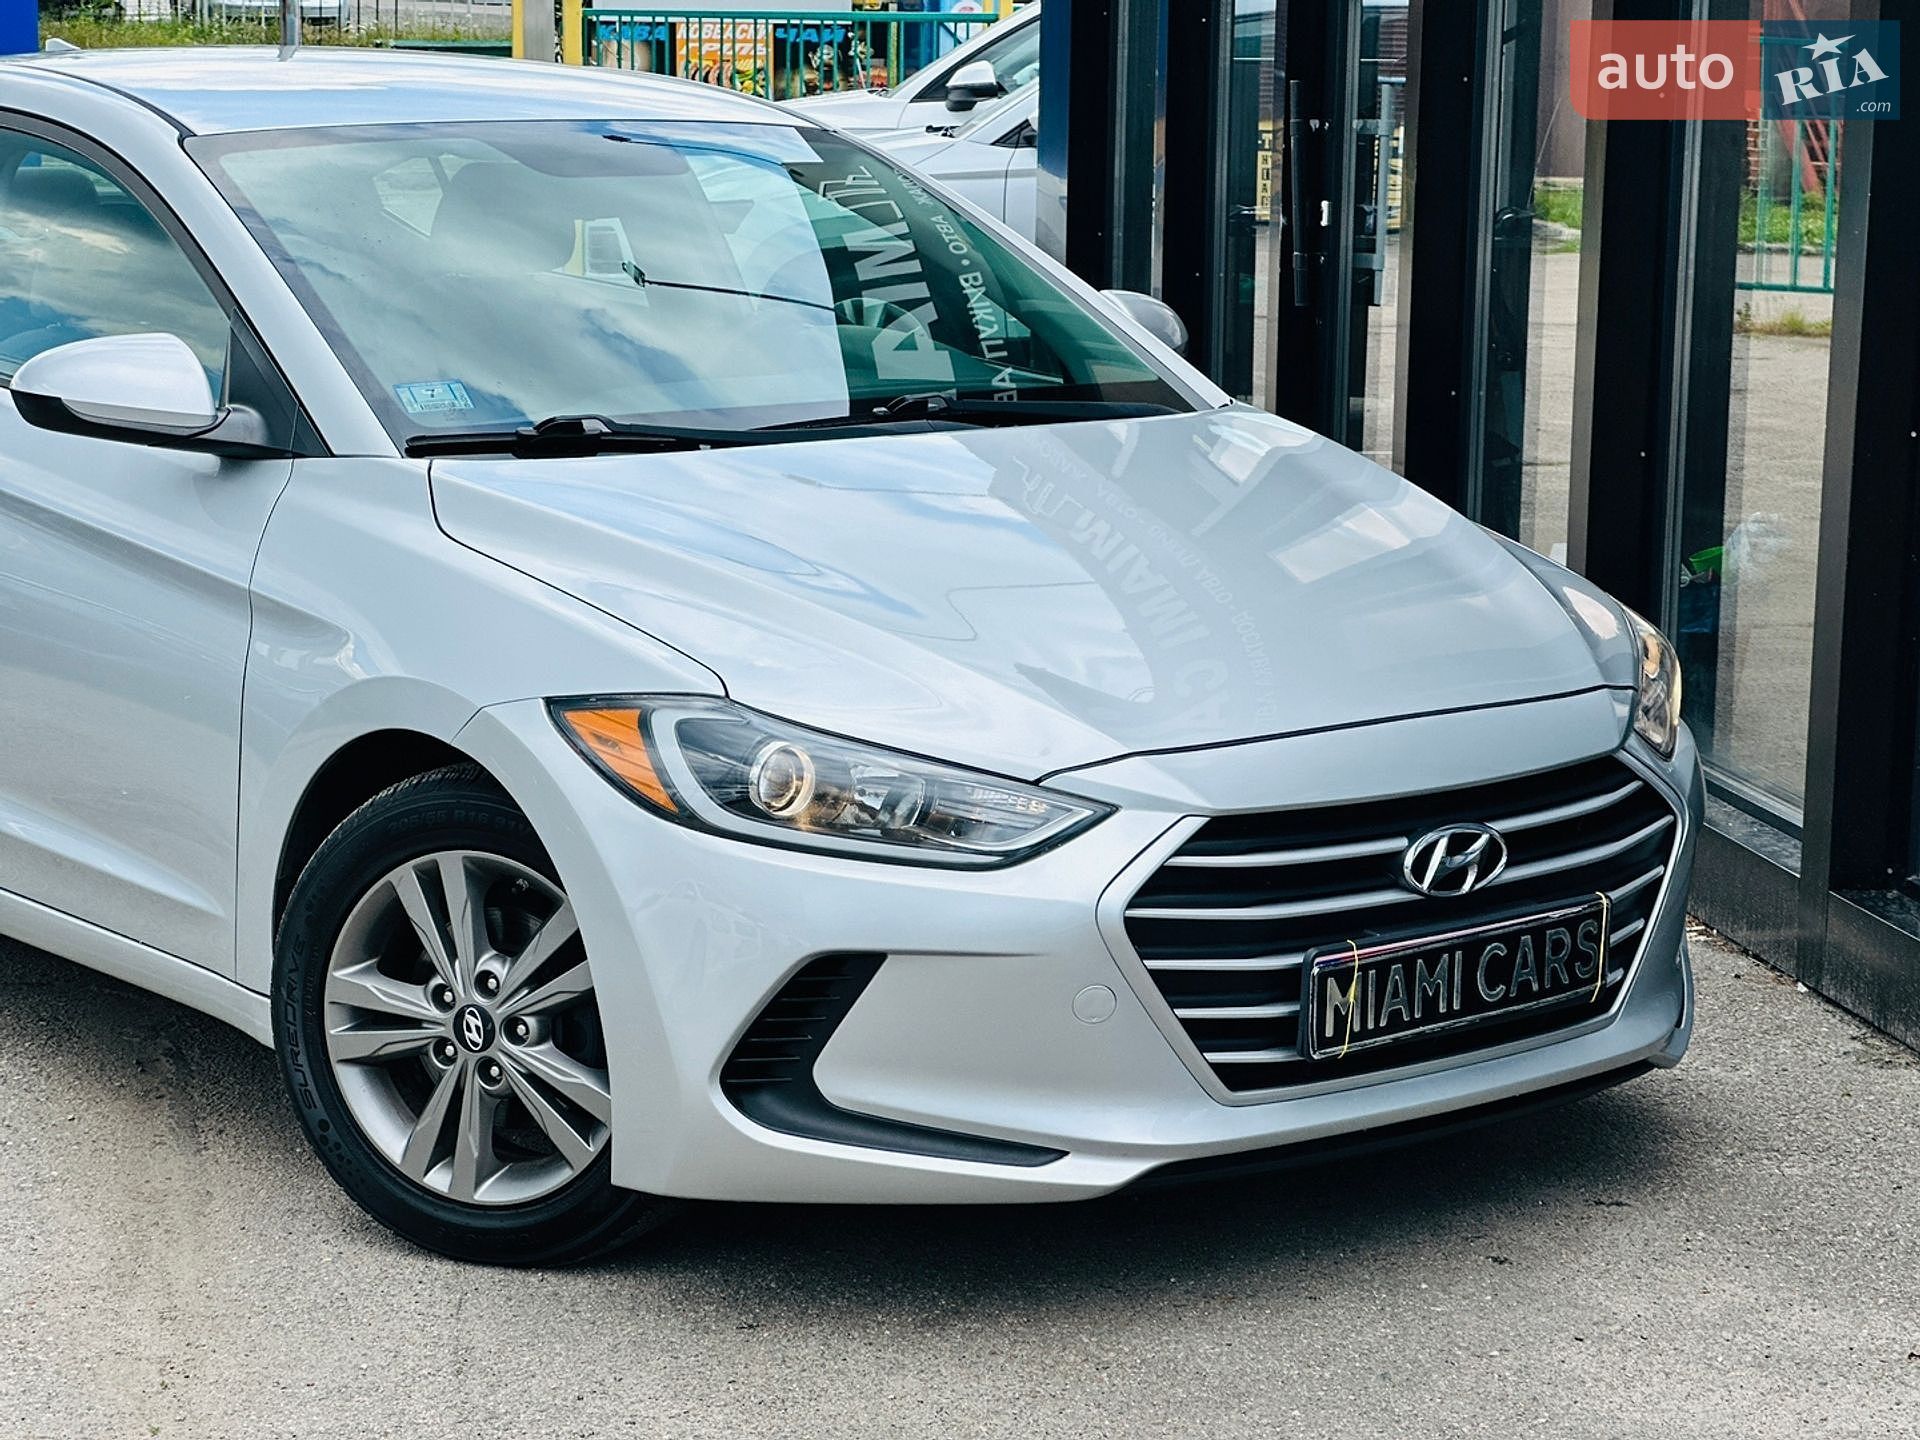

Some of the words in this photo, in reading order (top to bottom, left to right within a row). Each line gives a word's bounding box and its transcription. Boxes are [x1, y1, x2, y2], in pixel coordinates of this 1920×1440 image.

[775, 26, 846, 43] ЧАЙ
[1325, 950, 1463, 1038] MIAMI
[1477, 919, 1599, 1002] CARS
